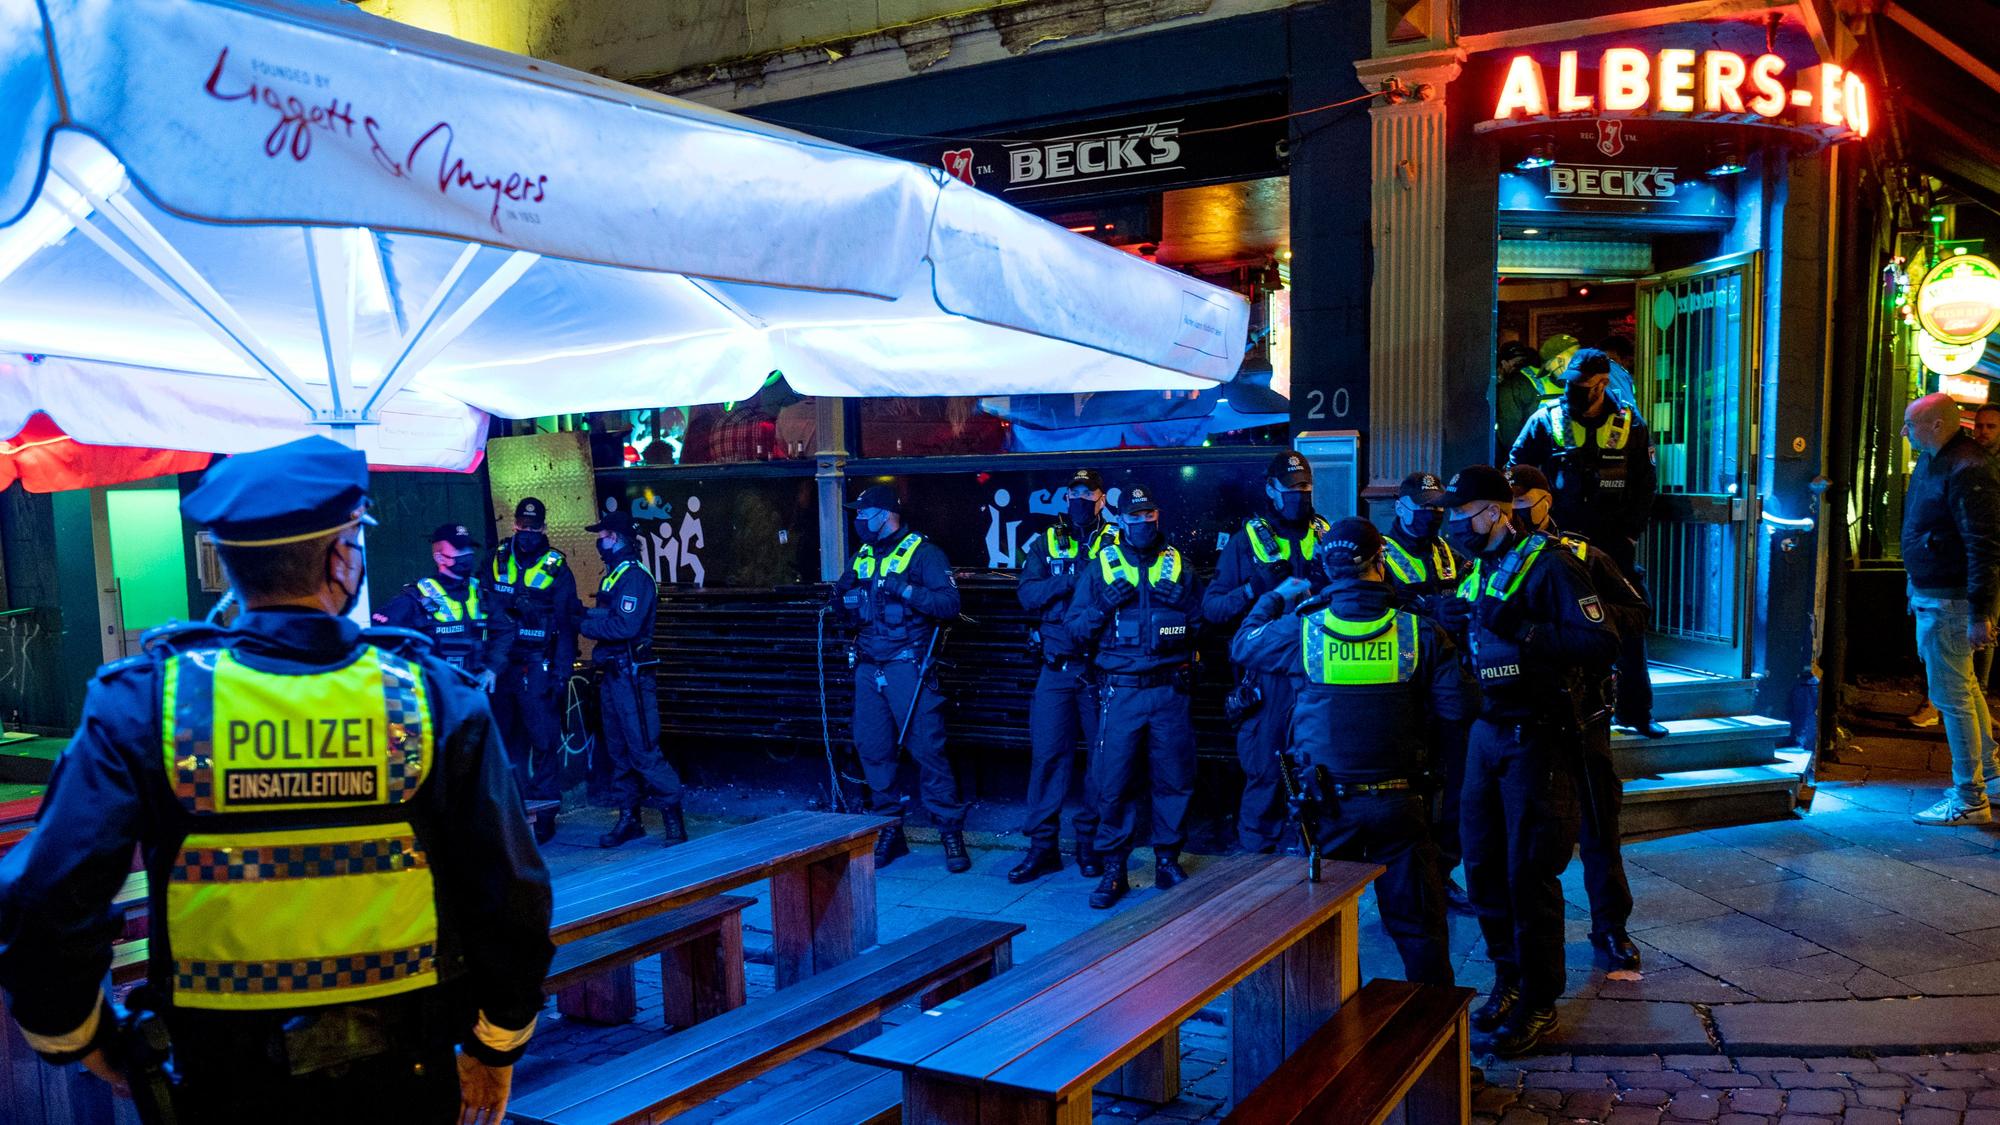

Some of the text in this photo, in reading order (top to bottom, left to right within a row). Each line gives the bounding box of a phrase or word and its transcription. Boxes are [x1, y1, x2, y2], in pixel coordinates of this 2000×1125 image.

[204, 46, 354, 162] Liggett
[406, 121, 548, 233] Myers
[1010, 124, 1181, 183] BECK'S
[1550, 167, 1676, 197] BECK'S
[1307, 388, 1350, 419] 20
[1600, 480, 1625, 488] POLIZEI
[1324, 540, 1358, 553] POLIZEI
[436, 624, 465, 635] POLIZEI
[520, 628, 546, 638] POLIZEI
[1159, 626, 1186, 636] POLIZEI
[1329, 641, 1393, 661] POLIZEI
[1480, 664, 1520, 679] POLIZEI
[228, 718, 375, 761] POLIZEI
[228, 771, 375, 799] EINSATZLEITUNG
